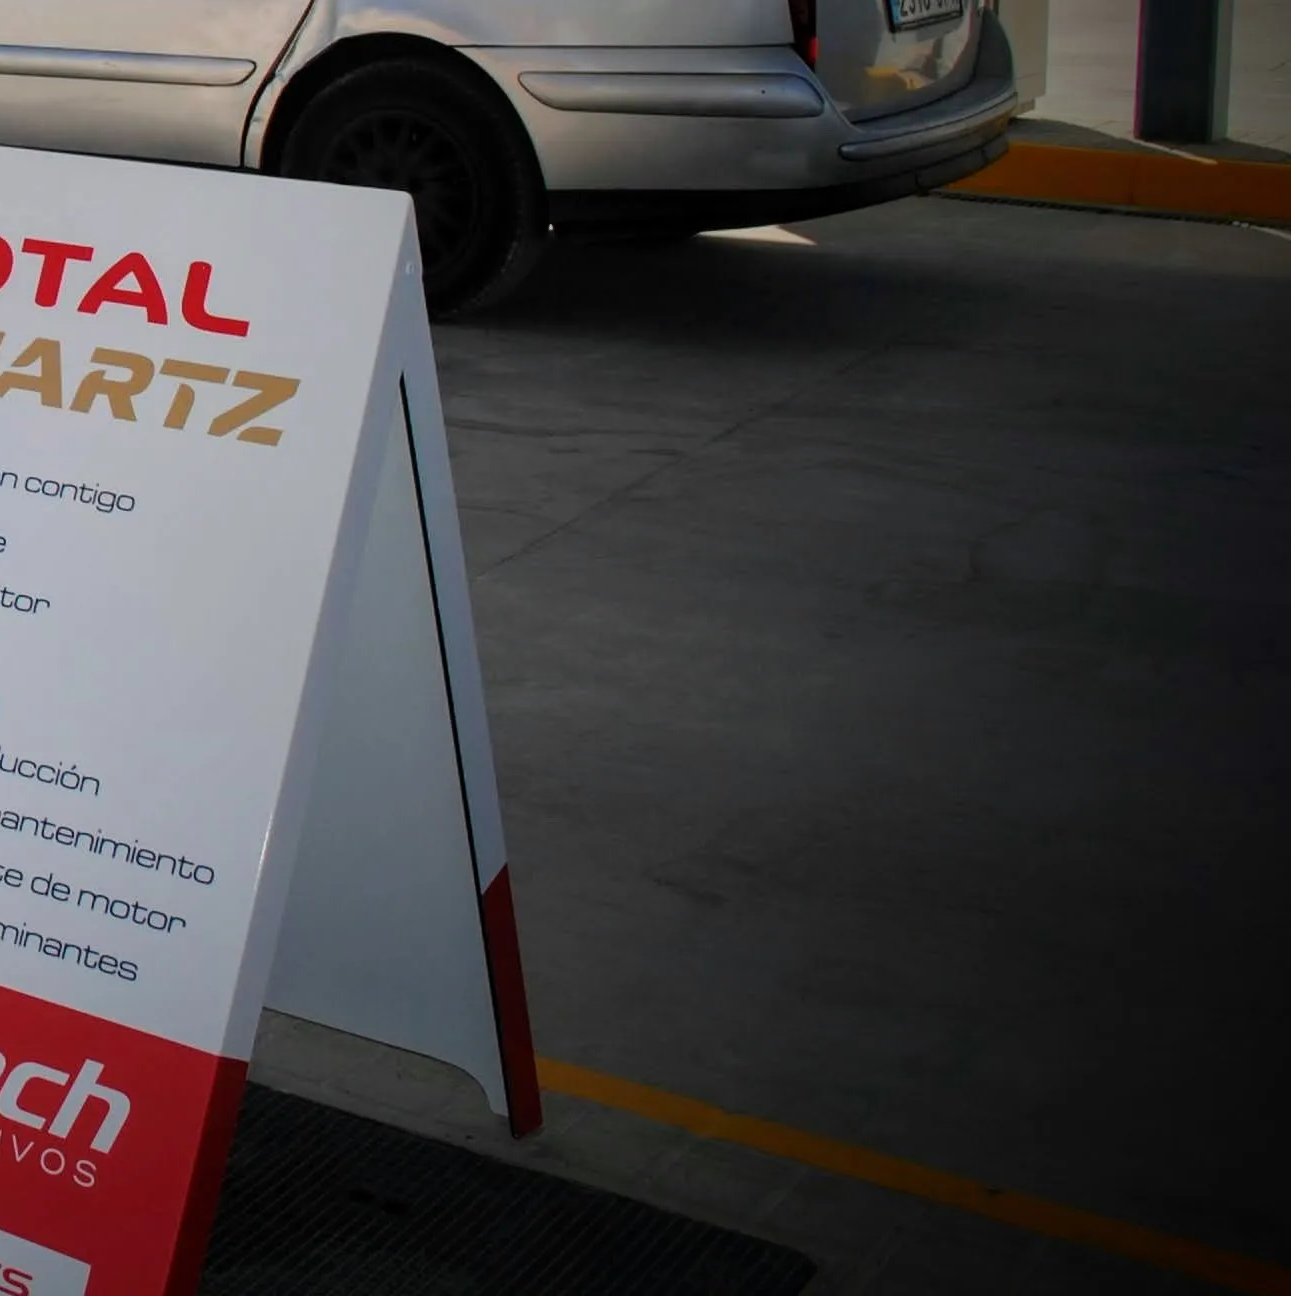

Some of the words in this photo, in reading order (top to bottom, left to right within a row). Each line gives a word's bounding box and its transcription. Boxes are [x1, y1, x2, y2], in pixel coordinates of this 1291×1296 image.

[24, 475, 136, 513] contigo
[30, 873, 71, 902] de
[76, 888, 187, 935] motor
